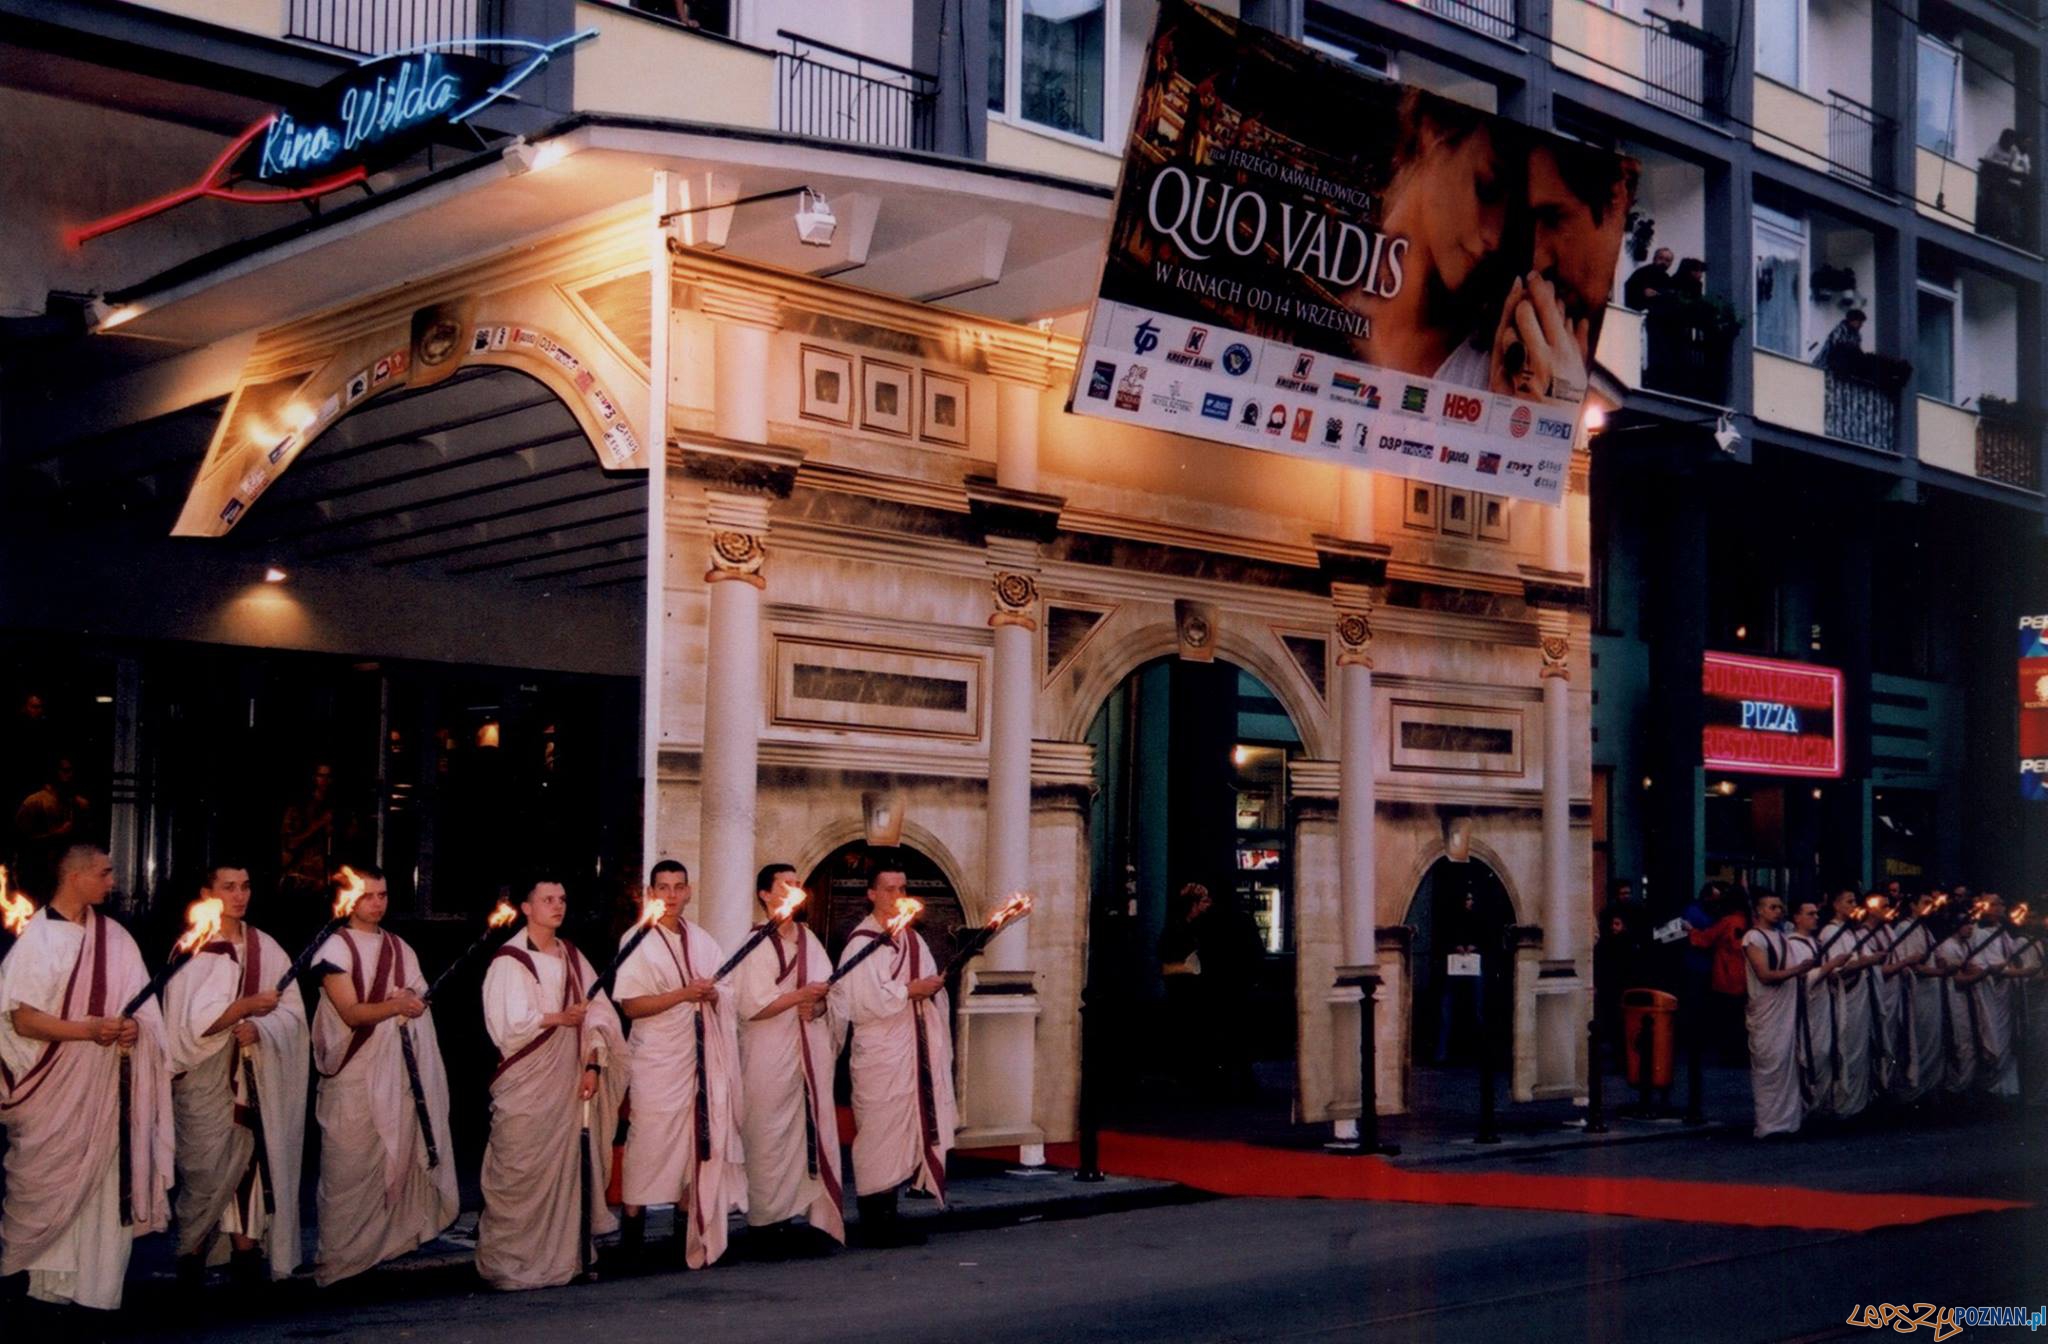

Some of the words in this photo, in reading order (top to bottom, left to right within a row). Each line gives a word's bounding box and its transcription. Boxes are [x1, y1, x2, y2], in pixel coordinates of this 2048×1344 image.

[260, 114, 333, 178] Kino
[342, 53, 460, 150] Wilda
[1227, 149, 1278, 178] JERZEGO
[1280, 167, 1370, 210] KAWALEROWICZA
[1148, 167, 1267, 260] QUO
[1280, 203, 1409, 298] VADIS
[1156, 261, 1173, 283] W
[1176, 268, 1242, 304] KINACH
[1247, 287, 1273, 311] OD
[1275, 296, 1290, 317] 14
[1296, 300, 1370, 338] WRZEŚNIA
[1443, 393, 1482, 422] HBO
[1740, 700, 1798, 733] PIZZA
[1702, 728, 1834, 767] RESTAURACJA
